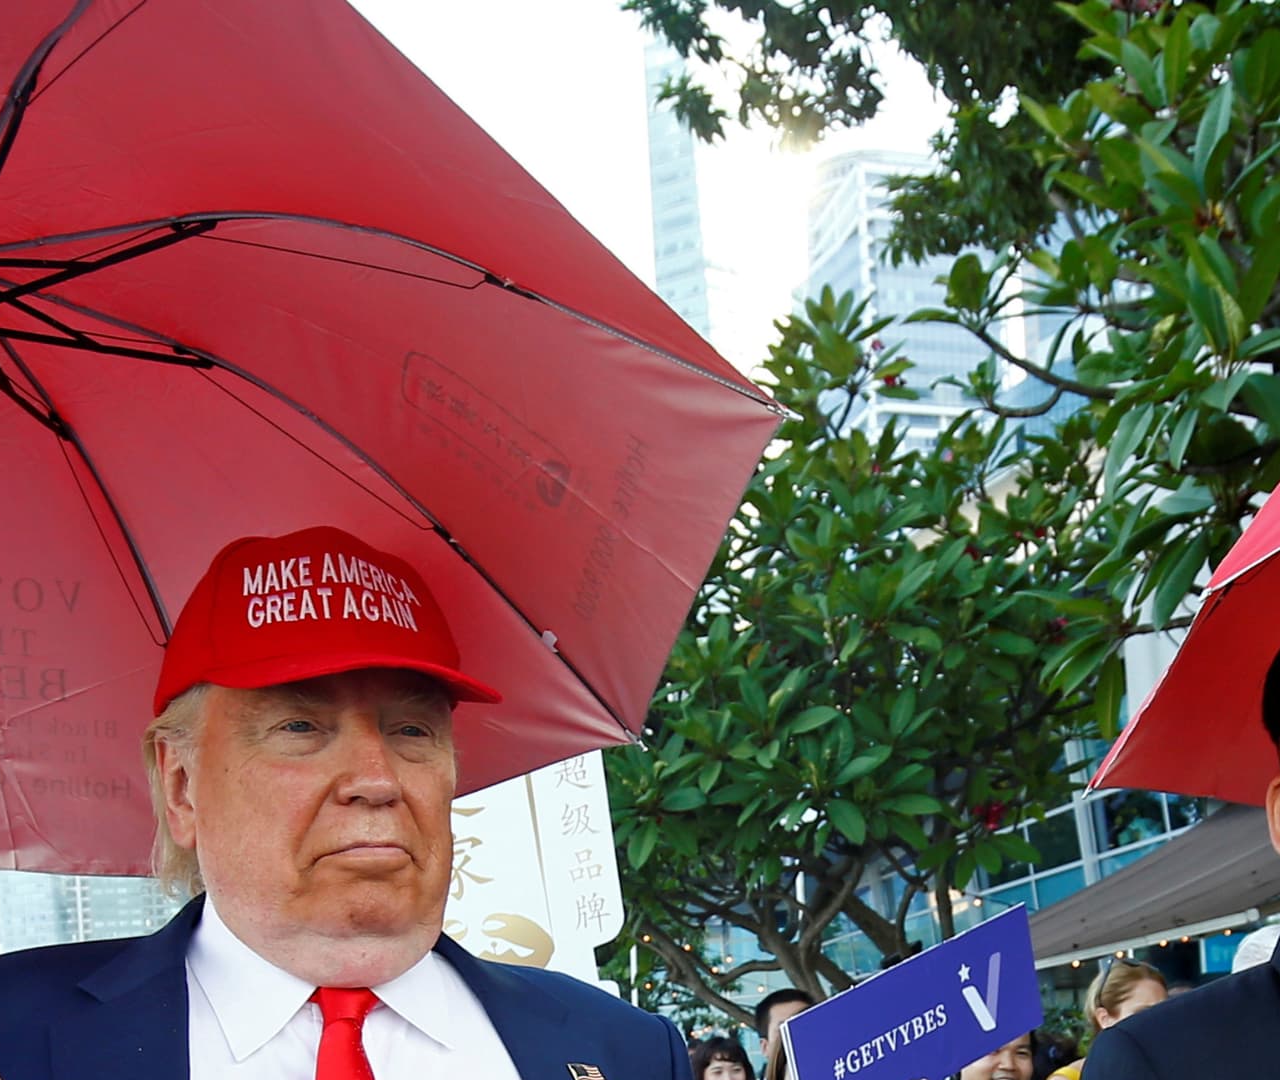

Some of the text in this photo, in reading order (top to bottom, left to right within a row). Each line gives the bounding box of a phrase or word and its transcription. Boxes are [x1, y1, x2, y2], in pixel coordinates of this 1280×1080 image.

[243, 552, 422, 607] MAKE AMERICA
[247, 587, 419, 632] GREAT AGAIN
[832, 1004, 948, 1080] #GETVYBES
